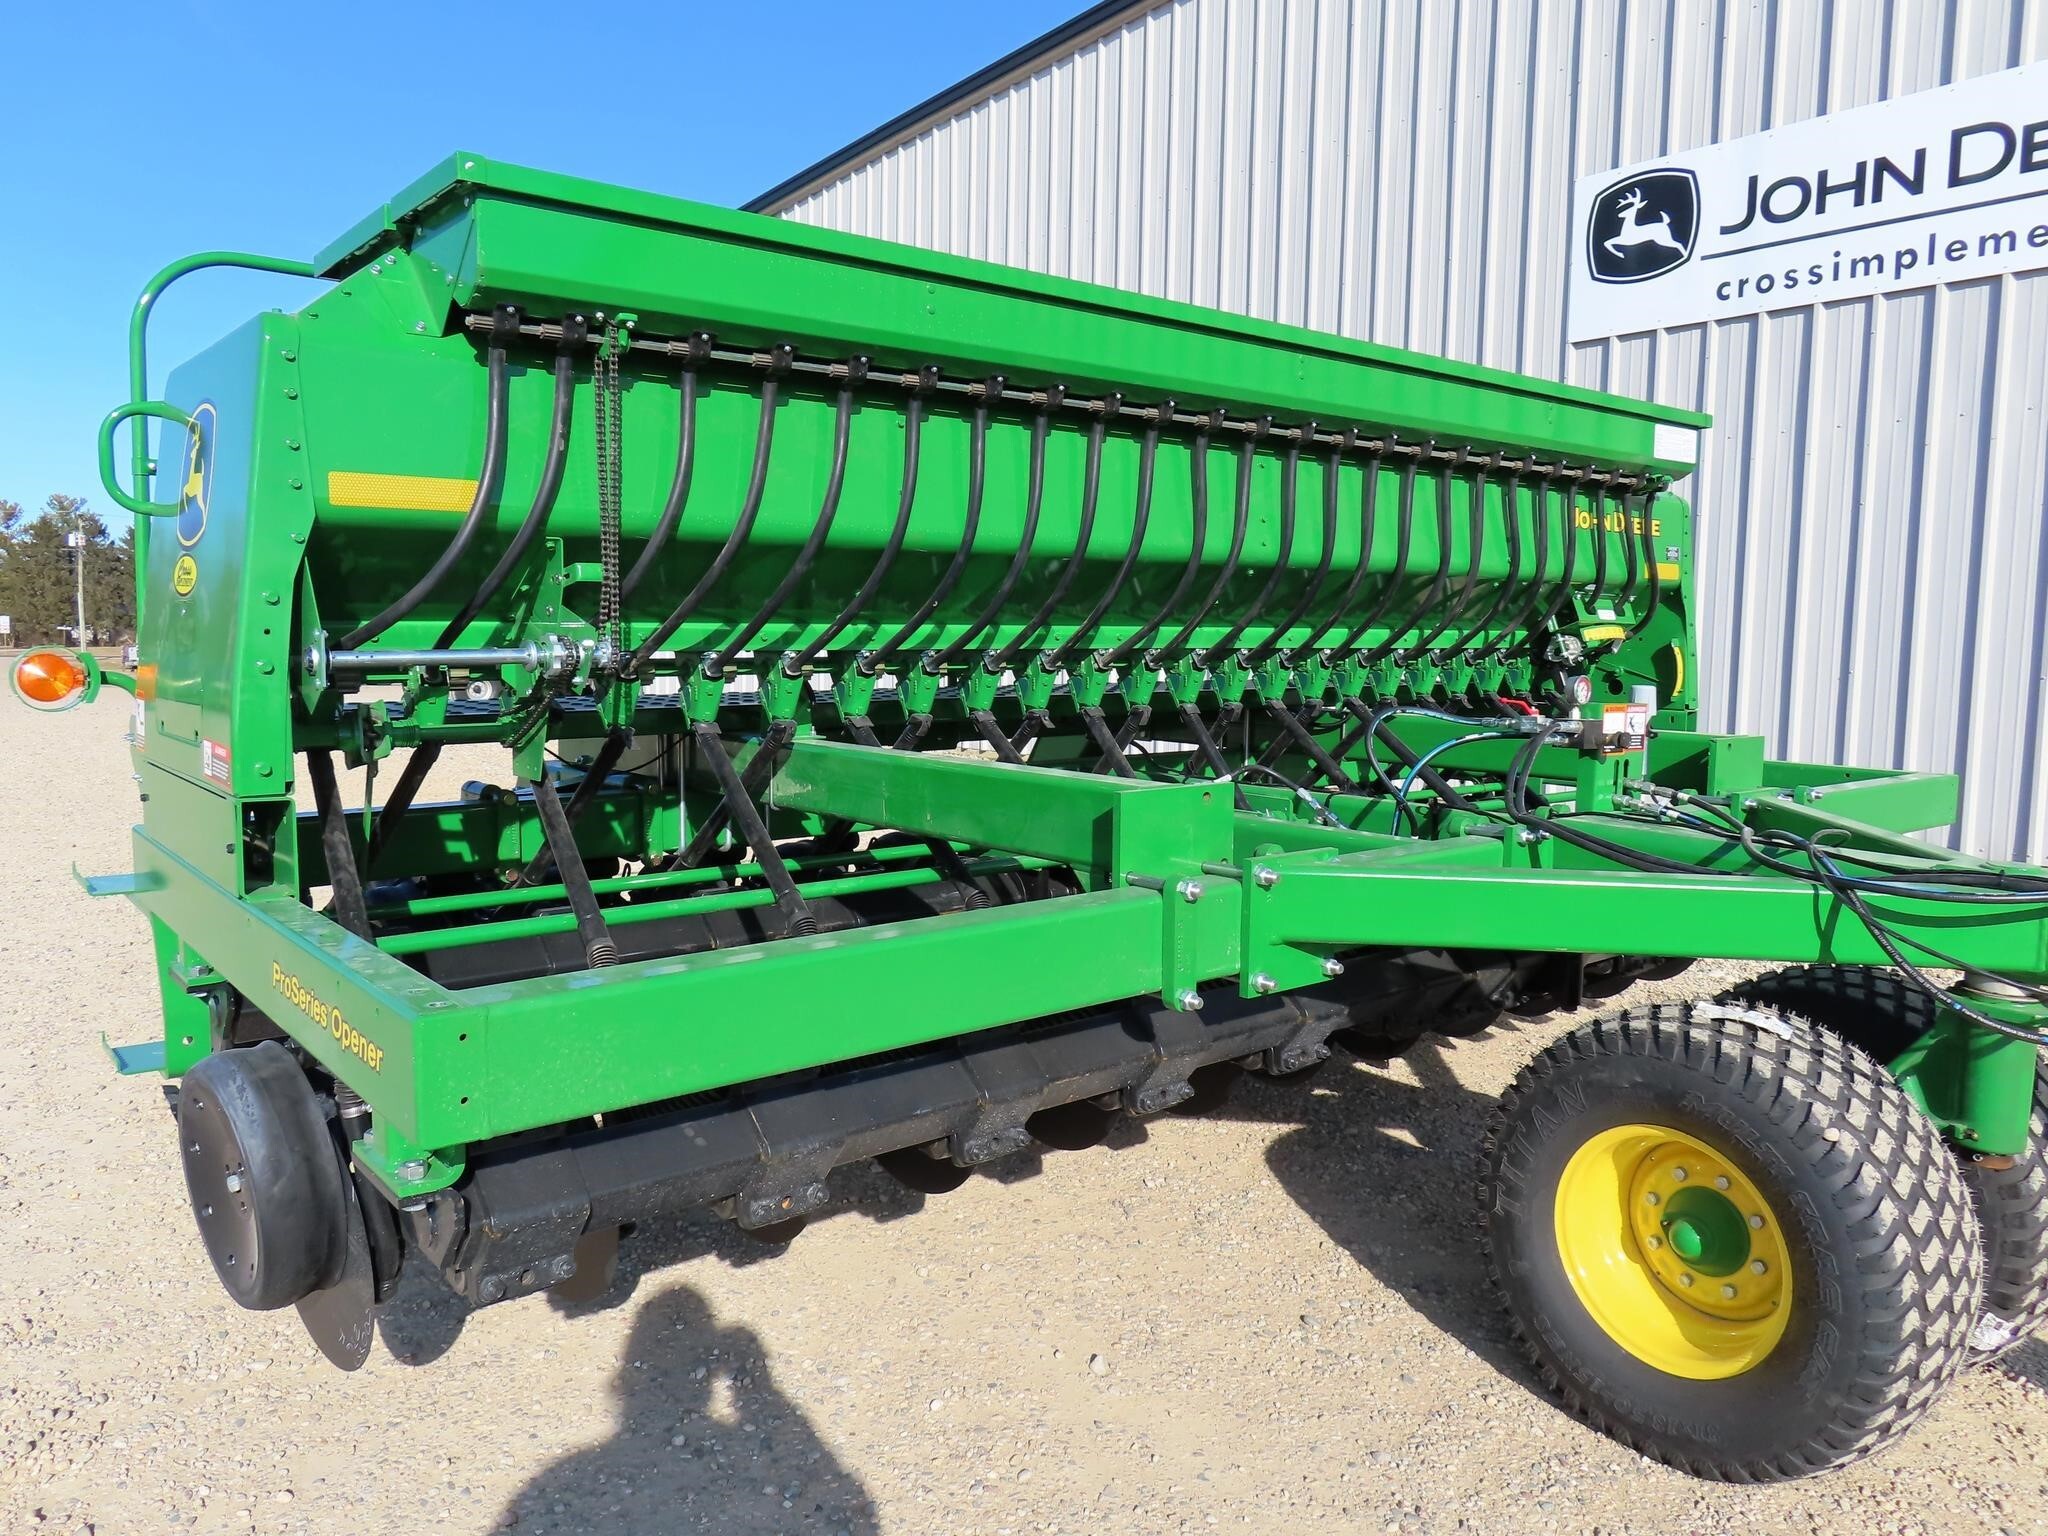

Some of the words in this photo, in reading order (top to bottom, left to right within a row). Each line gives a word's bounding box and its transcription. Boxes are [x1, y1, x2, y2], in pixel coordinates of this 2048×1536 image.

[1719, 147, 1927, 236] JOHN
[1716, 223, 2048, 301] crossimpleme
[1613, 511, 1661, 537] DEE
[272, 960, 329, 1029] ProSeries
[331, 1006, 385, 1073] Opener
[1491, 1075, 1589, 1223] TITAN
